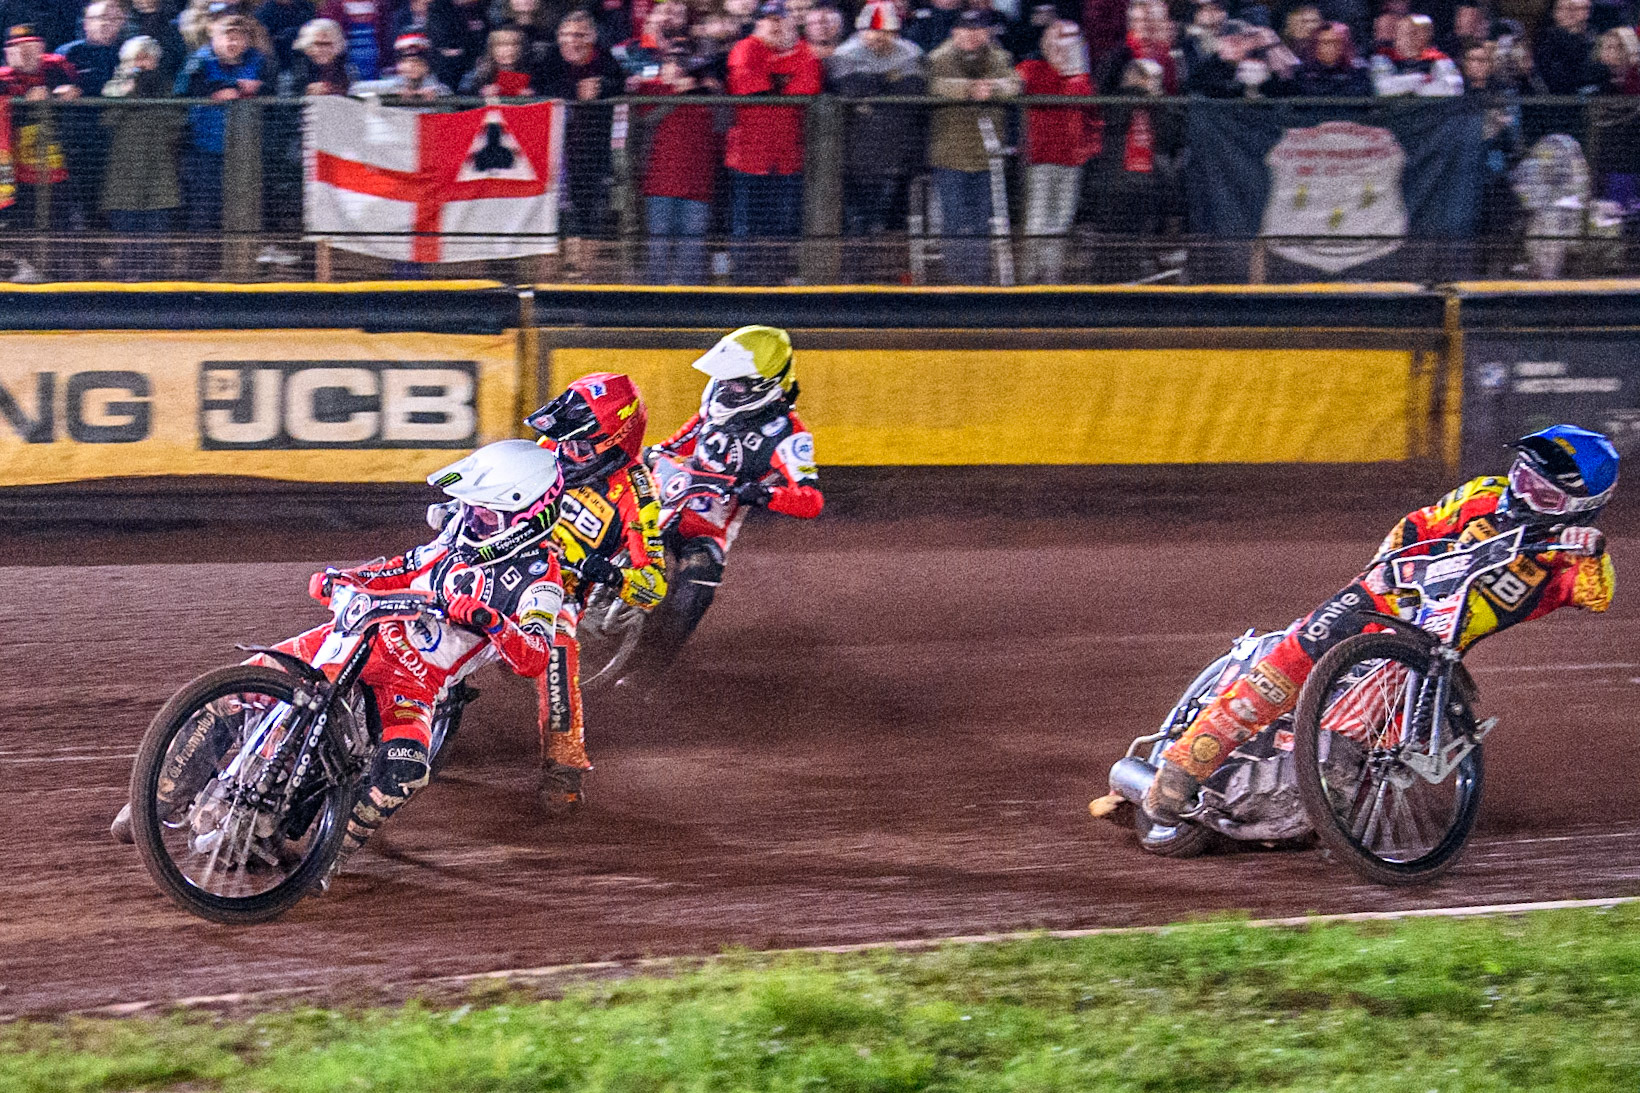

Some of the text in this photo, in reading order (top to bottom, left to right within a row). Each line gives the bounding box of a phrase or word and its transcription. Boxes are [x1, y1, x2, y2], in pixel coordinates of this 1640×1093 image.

[203, 367, 477, 443] JCB
[559, 494, 603, 539] CB
[502, 569, 518, 588] 5
[1302, 591, 1361, 643] ignite
[1247, 672, 1288, 703] JCB
